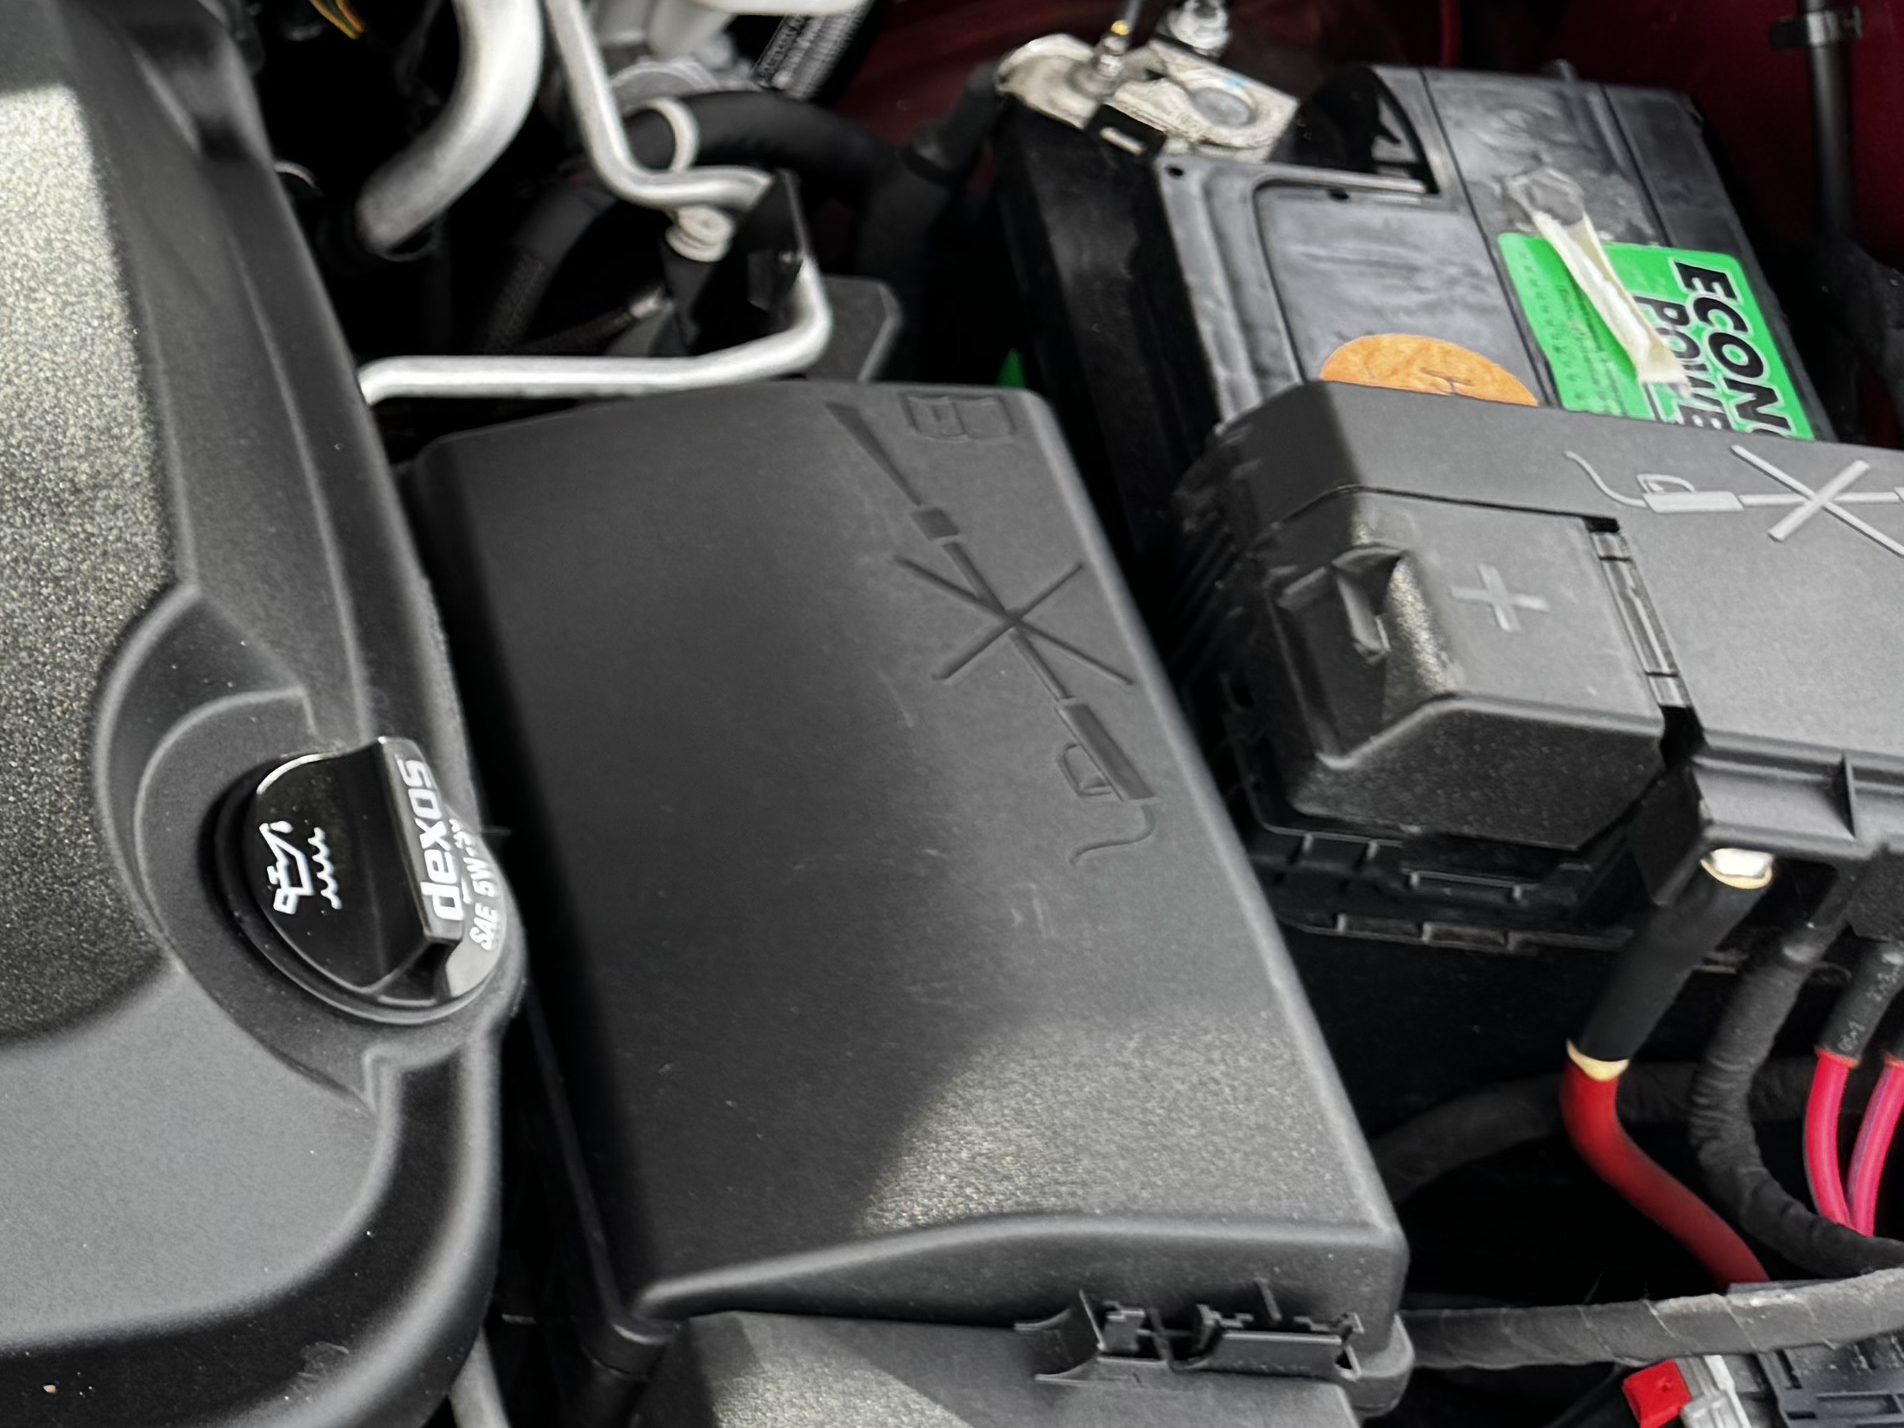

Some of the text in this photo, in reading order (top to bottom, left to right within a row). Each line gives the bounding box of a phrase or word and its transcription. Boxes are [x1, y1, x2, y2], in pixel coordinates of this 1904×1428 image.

[1670, 258, 1796, 439] ECON
[395, 753, 464, 922] dexos
[469, 902, 499, 952] SAE
